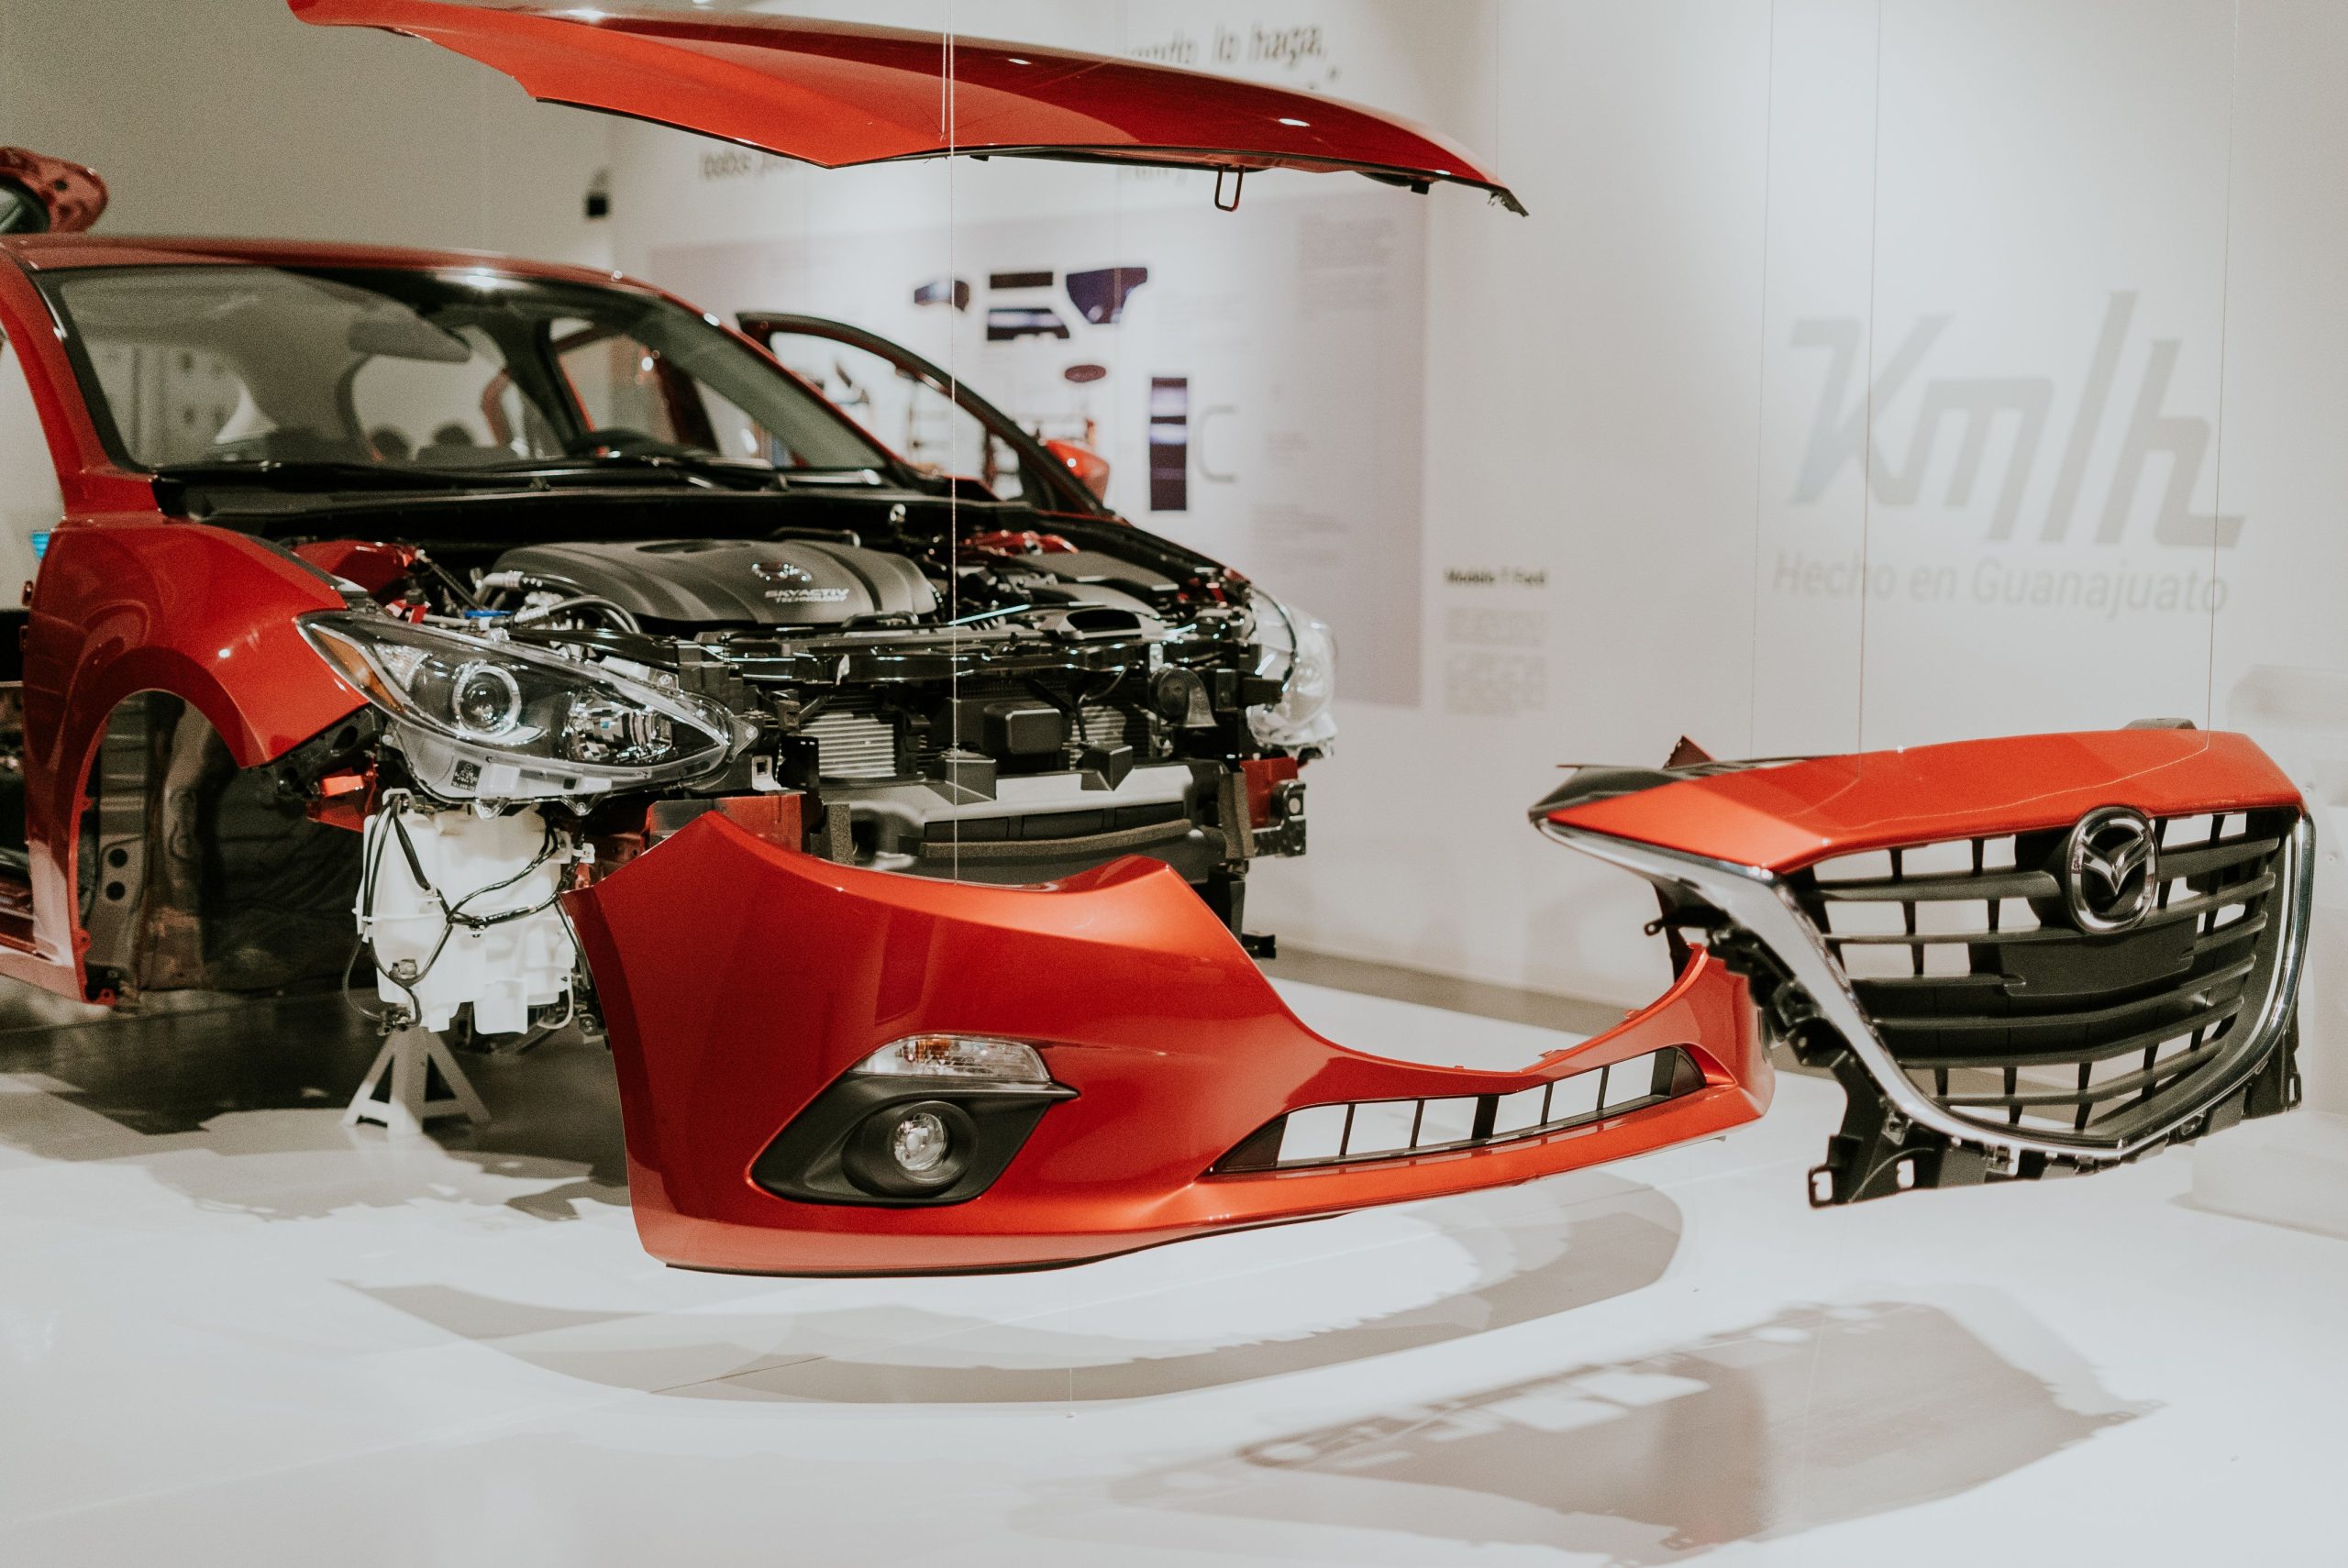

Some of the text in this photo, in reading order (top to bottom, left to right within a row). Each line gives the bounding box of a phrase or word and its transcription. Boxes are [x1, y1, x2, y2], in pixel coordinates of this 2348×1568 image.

[765, 588, 849, 599] SKYACTIV
[1772, 550, 2230, 620] Hecho en Guanajuato
